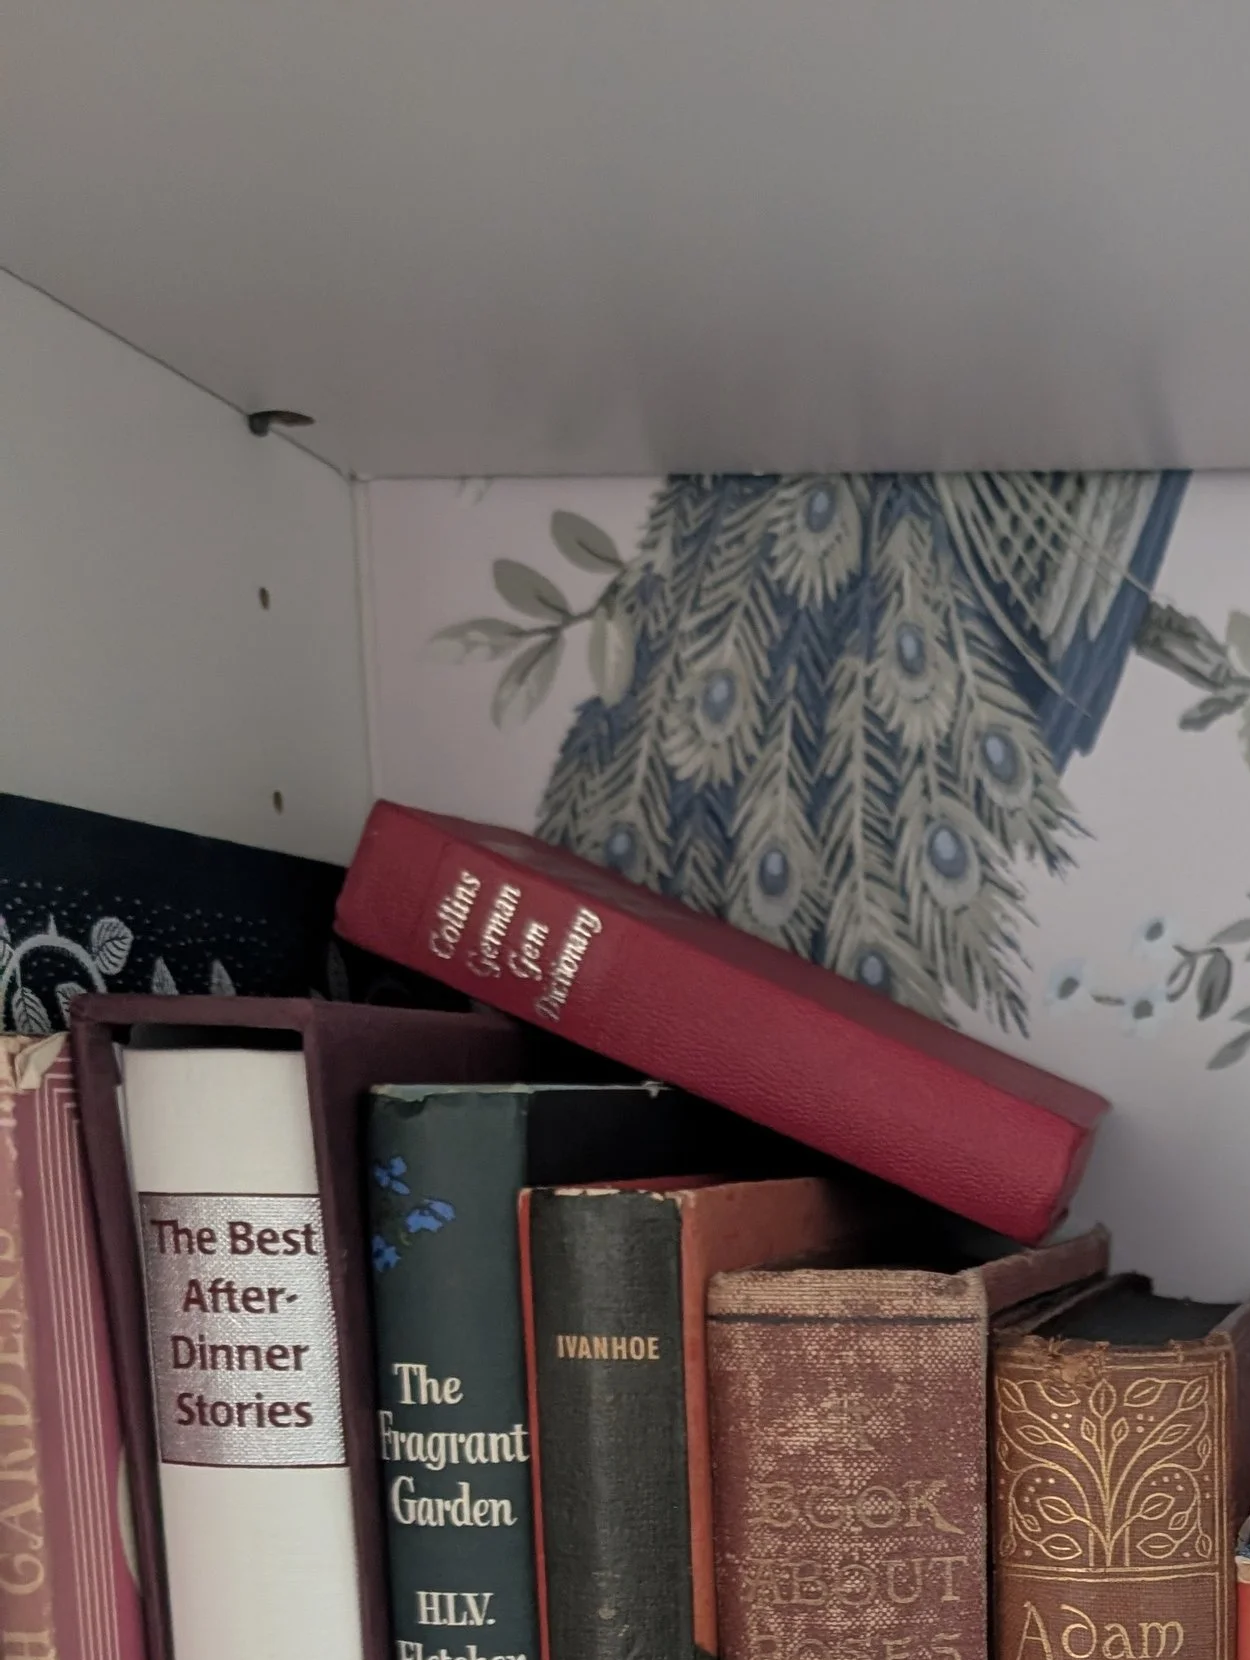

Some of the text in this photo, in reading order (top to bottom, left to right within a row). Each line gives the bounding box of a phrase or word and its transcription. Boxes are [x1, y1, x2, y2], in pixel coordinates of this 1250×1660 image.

[429, 868, 482, 961] Collins
[466, 882, 522, 979] German
[506, 920, 550, 982] Gem
[534, 905, 604, 1024] Dictionary
[150, 1219, 319, 1256] The Best
[182, 1277, 298, 1314] After-
[171, 1334, 310, 1372] Dinner
[556, 1335, 661, 1360] IVANHOE
[391, 1362, 463, 1405] The
[176, 1392, 314, 1428] Stories
[378, 1410, 530, 1472] Fragrant
[391, 1476, 518, 1527] Garden
[740, 1555, 970, 1606] ABOUT
